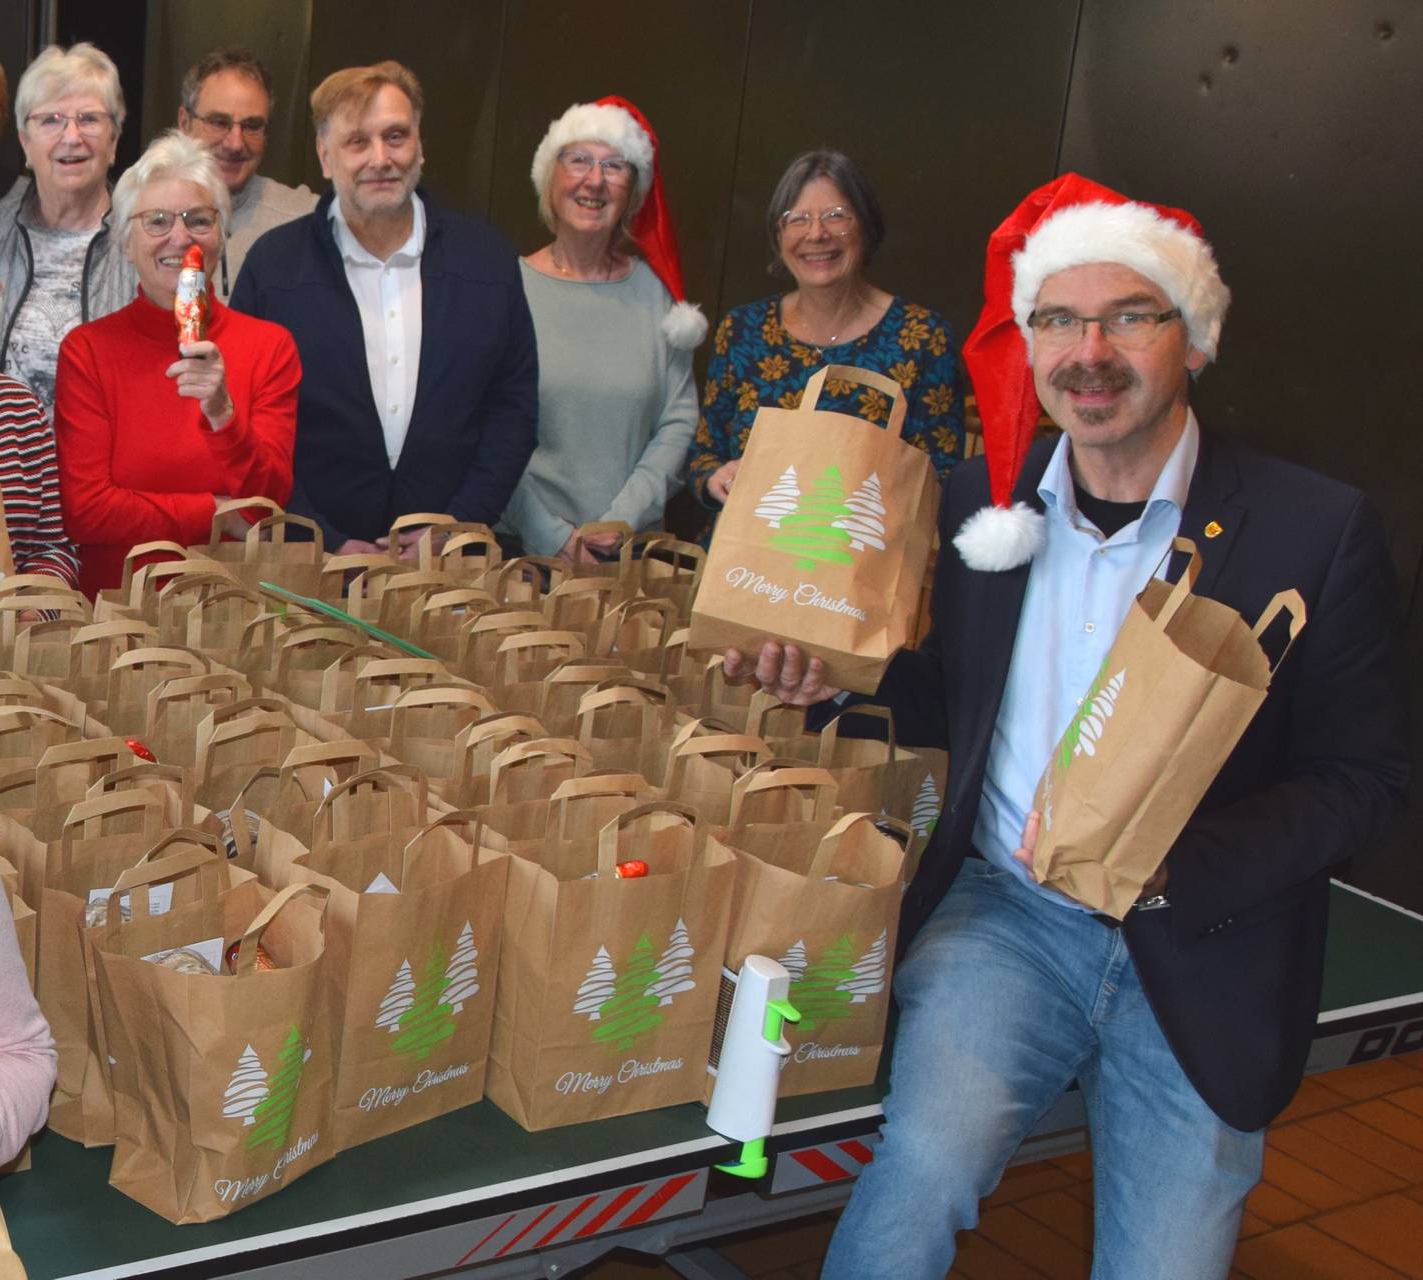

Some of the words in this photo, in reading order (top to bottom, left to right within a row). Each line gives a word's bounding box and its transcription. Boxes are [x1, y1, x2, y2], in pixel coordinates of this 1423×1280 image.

[726, 566, 788, 603] Merry
[793, 582, 866, 622] Christmas
[555, 1071, 613, 1096] Merry
[617, 1056, 683, 1084] Christmas
[794, 1041, 862, 1064] Christmas
[358, 1086, 409, 1112] Merry
[412, 1062, 470, 1093] Christmas
[272, 1128, 319, 1180] Cristma
